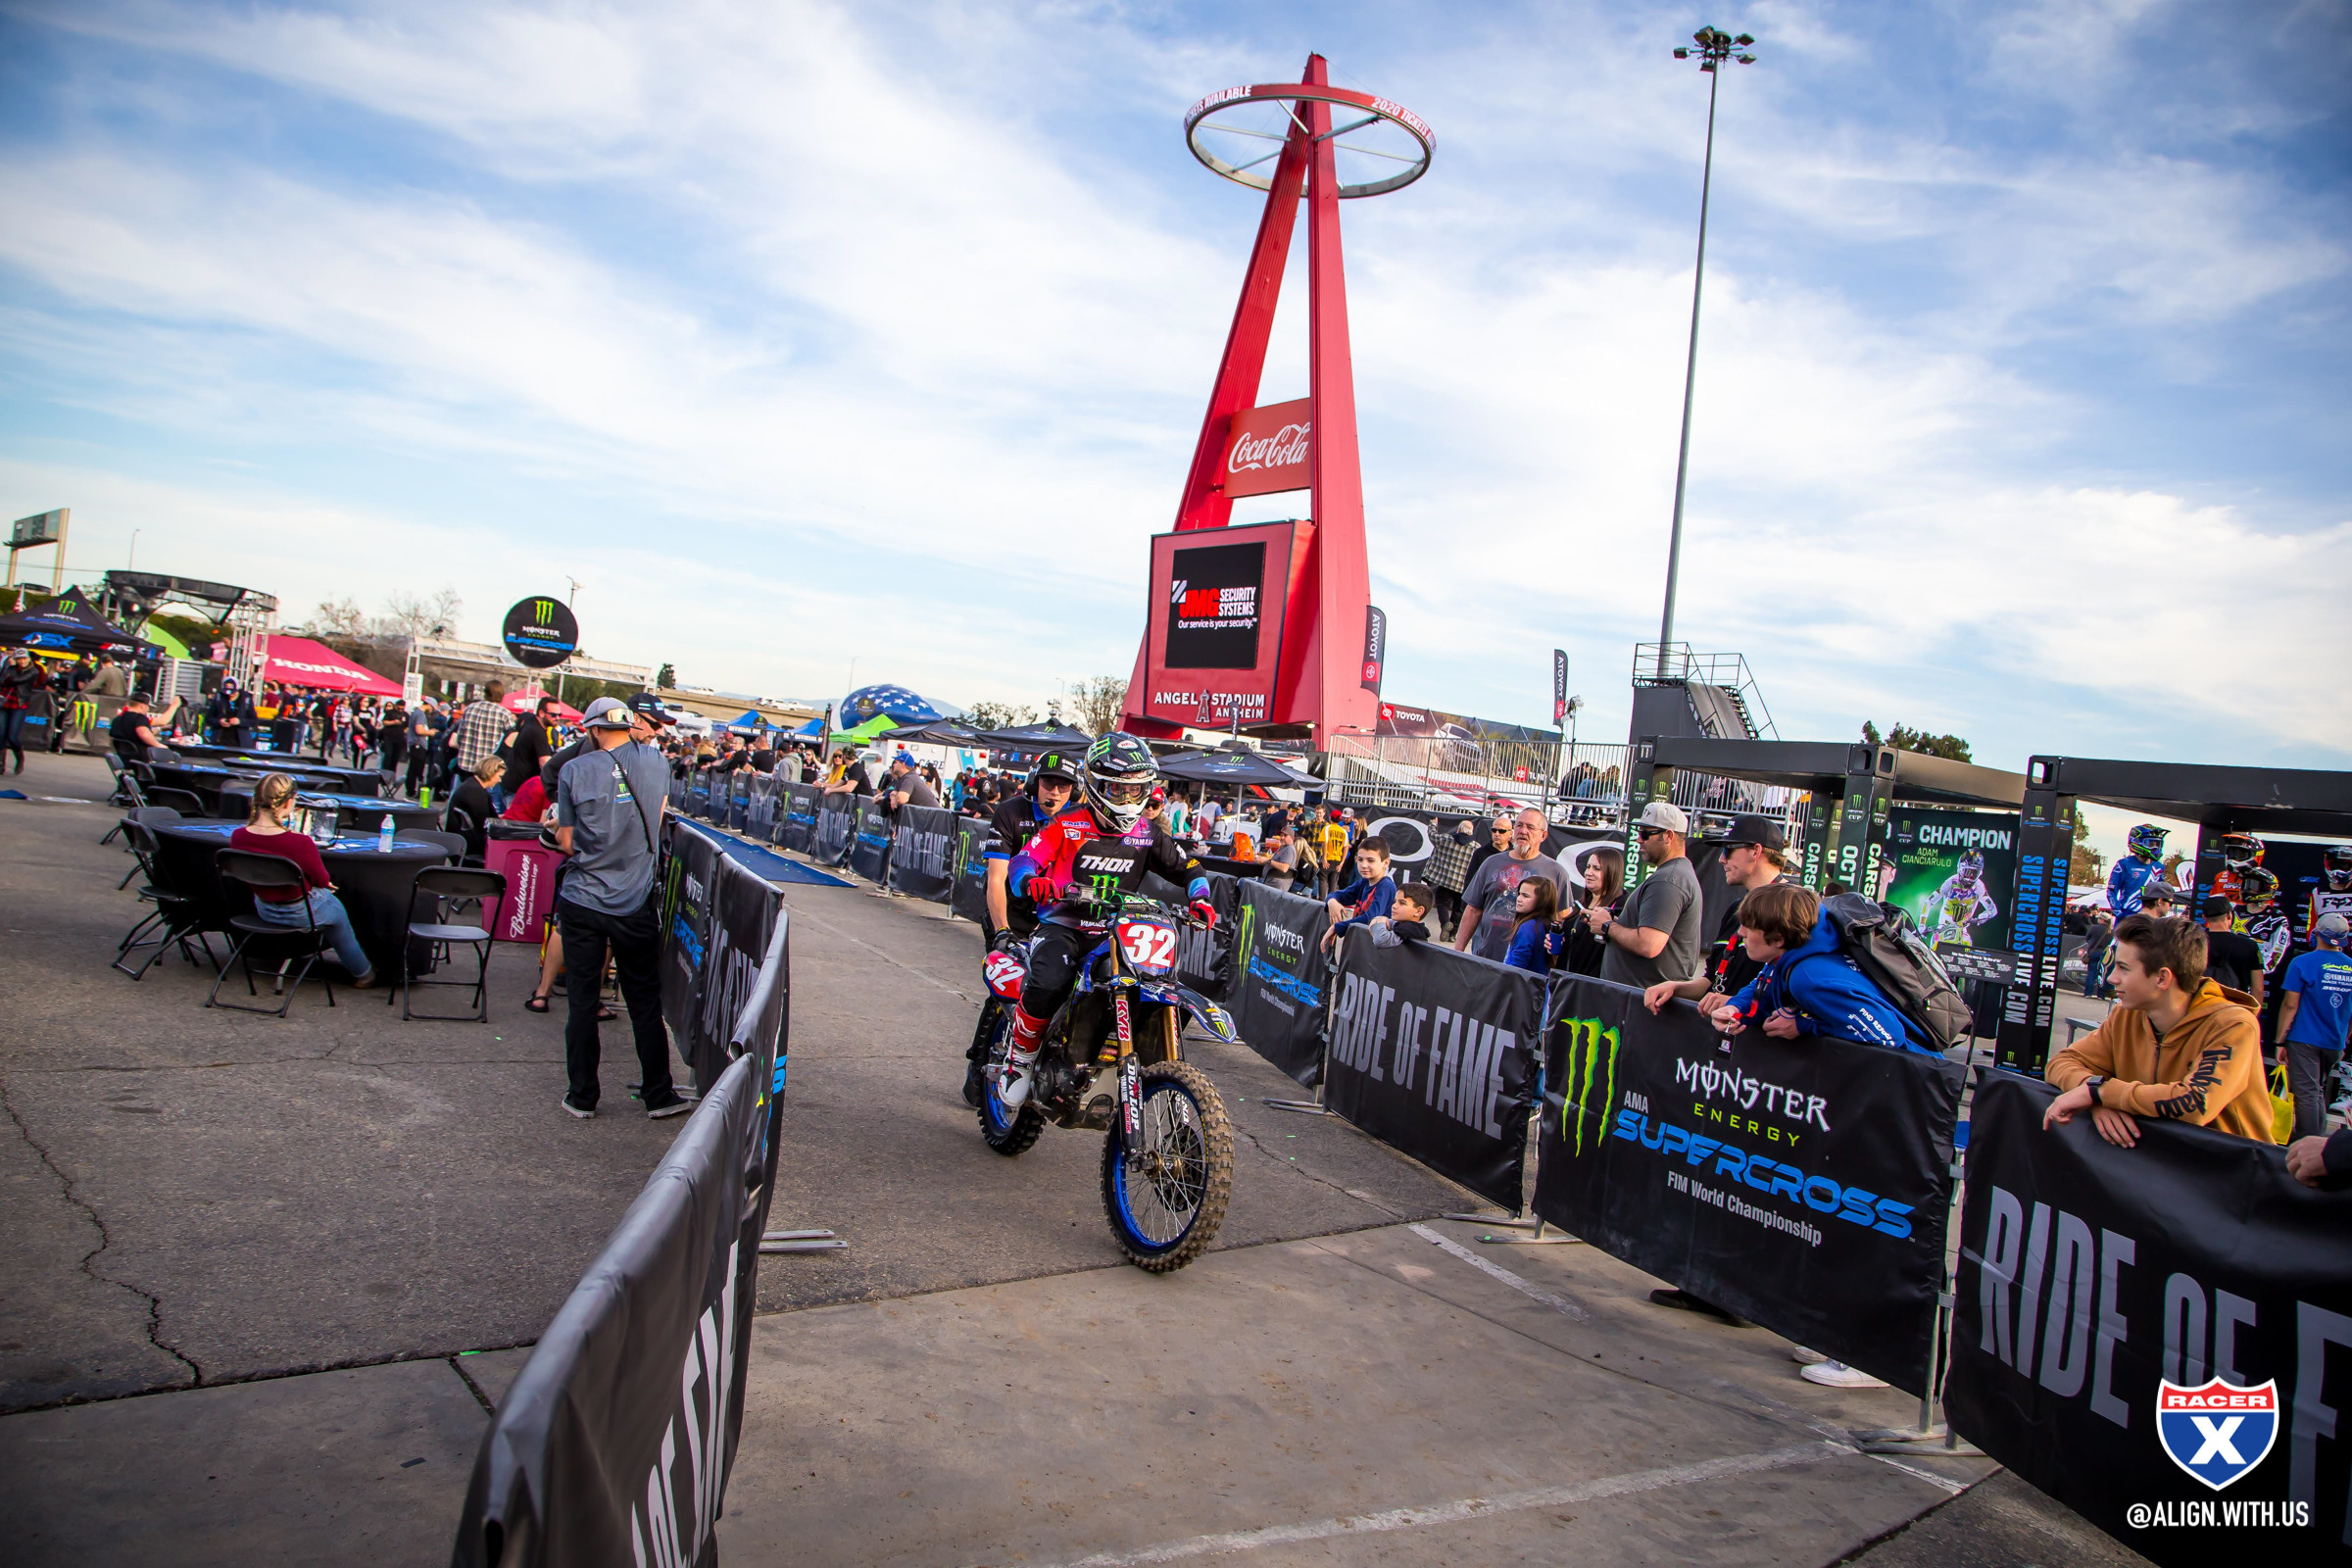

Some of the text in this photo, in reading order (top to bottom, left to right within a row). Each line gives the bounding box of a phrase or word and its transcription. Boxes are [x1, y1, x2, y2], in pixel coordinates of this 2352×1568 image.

[1204, 84, 1252, 109] AVAILABLE
[1371, 97, 1430, 137] 2020 TICKETS
[1228, 421, 1311, 473] Coca-Cola
[1179, 588, 1220, 618] JMG
[1219, 587, 1256, 602] SECURITY
[1218, 602, 1254, 616] SYSTEMS
[522, 625, 561, 637] MONSTER
[1178, 619, 1189, 628] Our
[1190, 619, 1208, 628] service
[1215, 620, 1229, 630] your
[271, 658, 371, 681] HONDA
[1154, 692, 1265, 707] ANGEL STADIUM
[1215, 708, 1264, 718] ANHEIM
[1396, 710, 1425, 723] TOYOTA
[1919, 824, 2012, 850] CHAMPION
[1079, 855, 1135, 872] THOR
[1902, 855, 1952, 868] CIANCIARULO
[1917, 847, 1938, 858] ADAM
[1838, 845, 1859, 887] OCT
[510, 854, 531, 938] Budweiser
[1124, 924, 1176, 967] 32
[1264, 921, 1304, 955] MONSTER
[1267, 946, 1298, 965] ENERGY
[986, 957, 1025, 992] 32
[1117, 1000, 1130, 1042] KYB
[1859, 1007, 1875, 1022] FIND
[1333, 971, 1516, 1141] RIDE OF FAME
[1624, 1090, 1649, 1113] AMA
[1676, 1056, 1830, 1132] MONSTER
[1693, 1102, 1799, 1148] ENERGY
[1612, 1108, 1915, 1240] SUPERCROSS
[1667, 1170, 1822, 1248] FIM World Championship
[1980, 1186, 2135, 1429] RIDE
